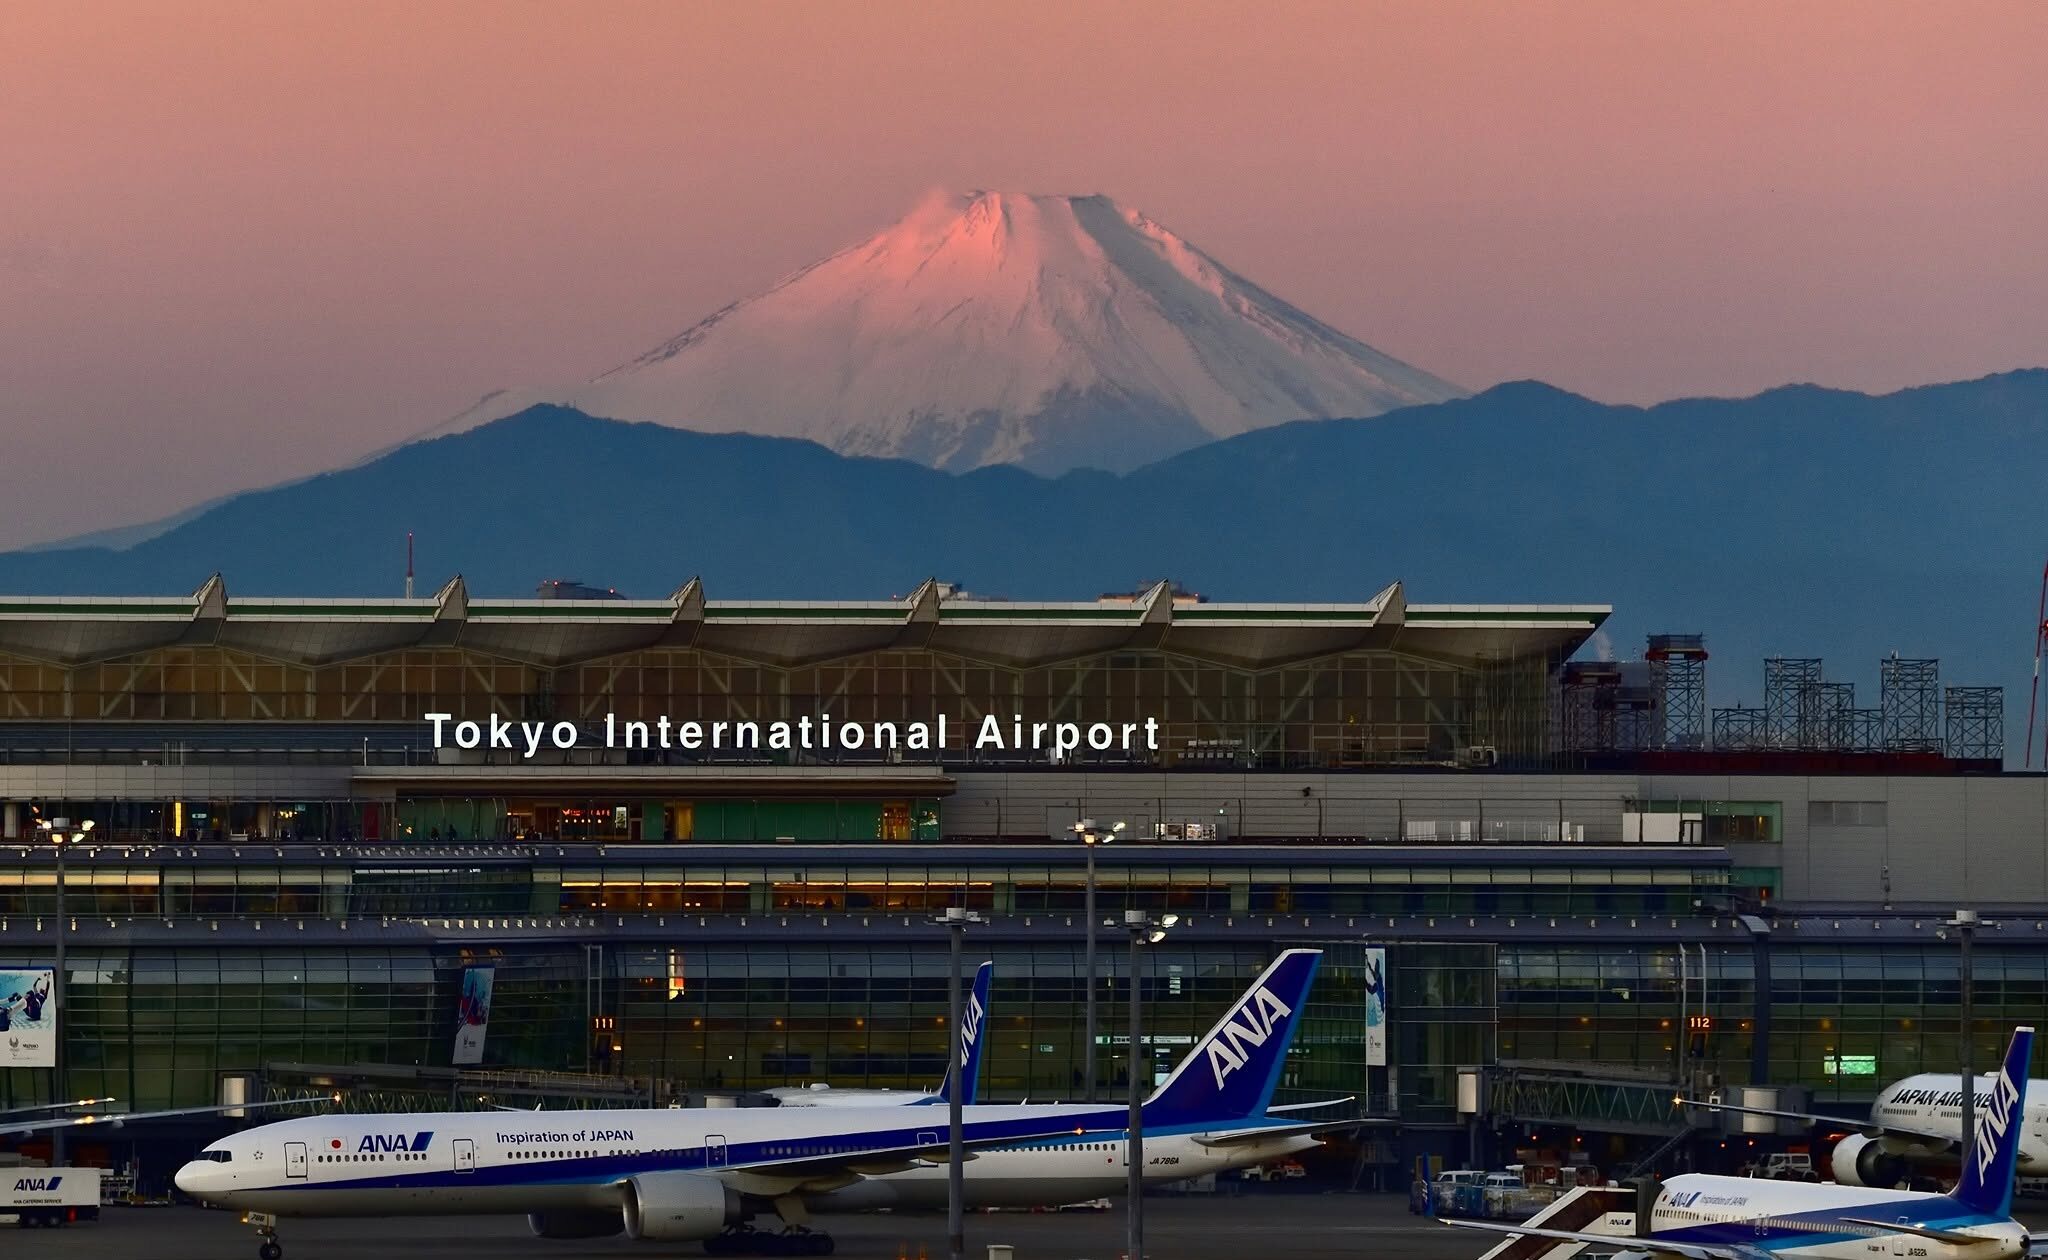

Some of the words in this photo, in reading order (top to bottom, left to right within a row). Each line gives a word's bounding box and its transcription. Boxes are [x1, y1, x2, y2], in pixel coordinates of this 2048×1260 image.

[424, 713, 578, 758] Tokyo
[606, 713, 946, 750] International
[975, 714, 1159, 759] Airport
[595, 1018, 613, 1029] 111
[1690, 1017, 1710, 1028] 112
[1206, 985, 1292, 1091] ANA
[1891, 1088, 1940, 1106] JAPAN
[1935, 1090, 1993, 1109] AIRNE
[1977, 1066, 2020, 1187] ANA
[358, 1134, 409, 1152] ANA
[496, 1131, 569, 1145] Inspiration
[572, 1130, 586, 1142] of
[589, 1130, 634, 1142] JAPAN
[14, 1178, 46, 1191] ANA
